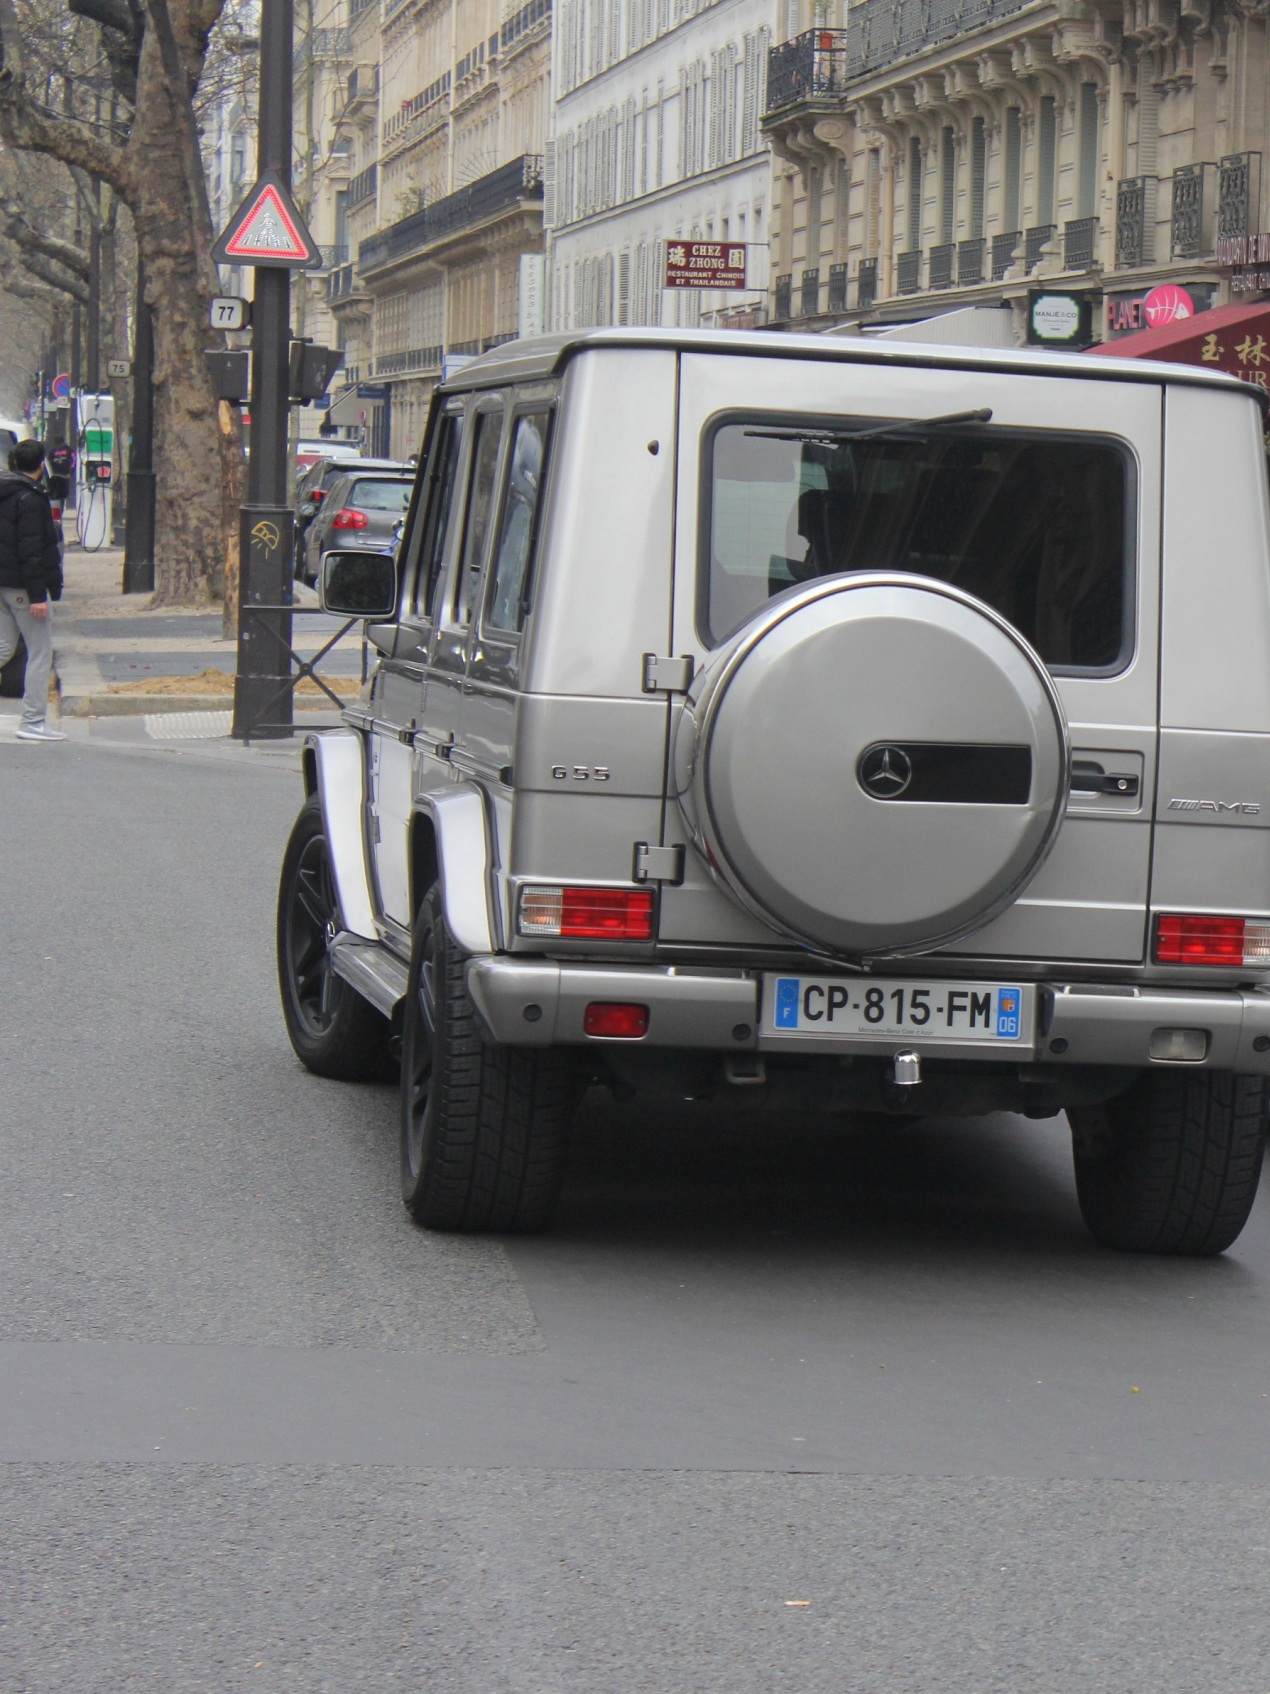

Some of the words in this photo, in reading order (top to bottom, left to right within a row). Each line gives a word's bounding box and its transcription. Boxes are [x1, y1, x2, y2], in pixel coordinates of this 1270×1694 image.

[692, 245, 721, 256] CHEZ
[689, 257, 725, 269] ZHONG
[690, 279, 736, 287] THAILANDAIS
[218, 306, 235, 321] 77
[1108, 298, 1142, 331] PLANET
[112, 364, 125, 374] 75
[1199, 800, 1260, 815] AMG
[783, 1007, 791, 1019] F
[803, 984, 992, 1029] CP-815-FM
[999, 1016, 1016, 1033] 06
